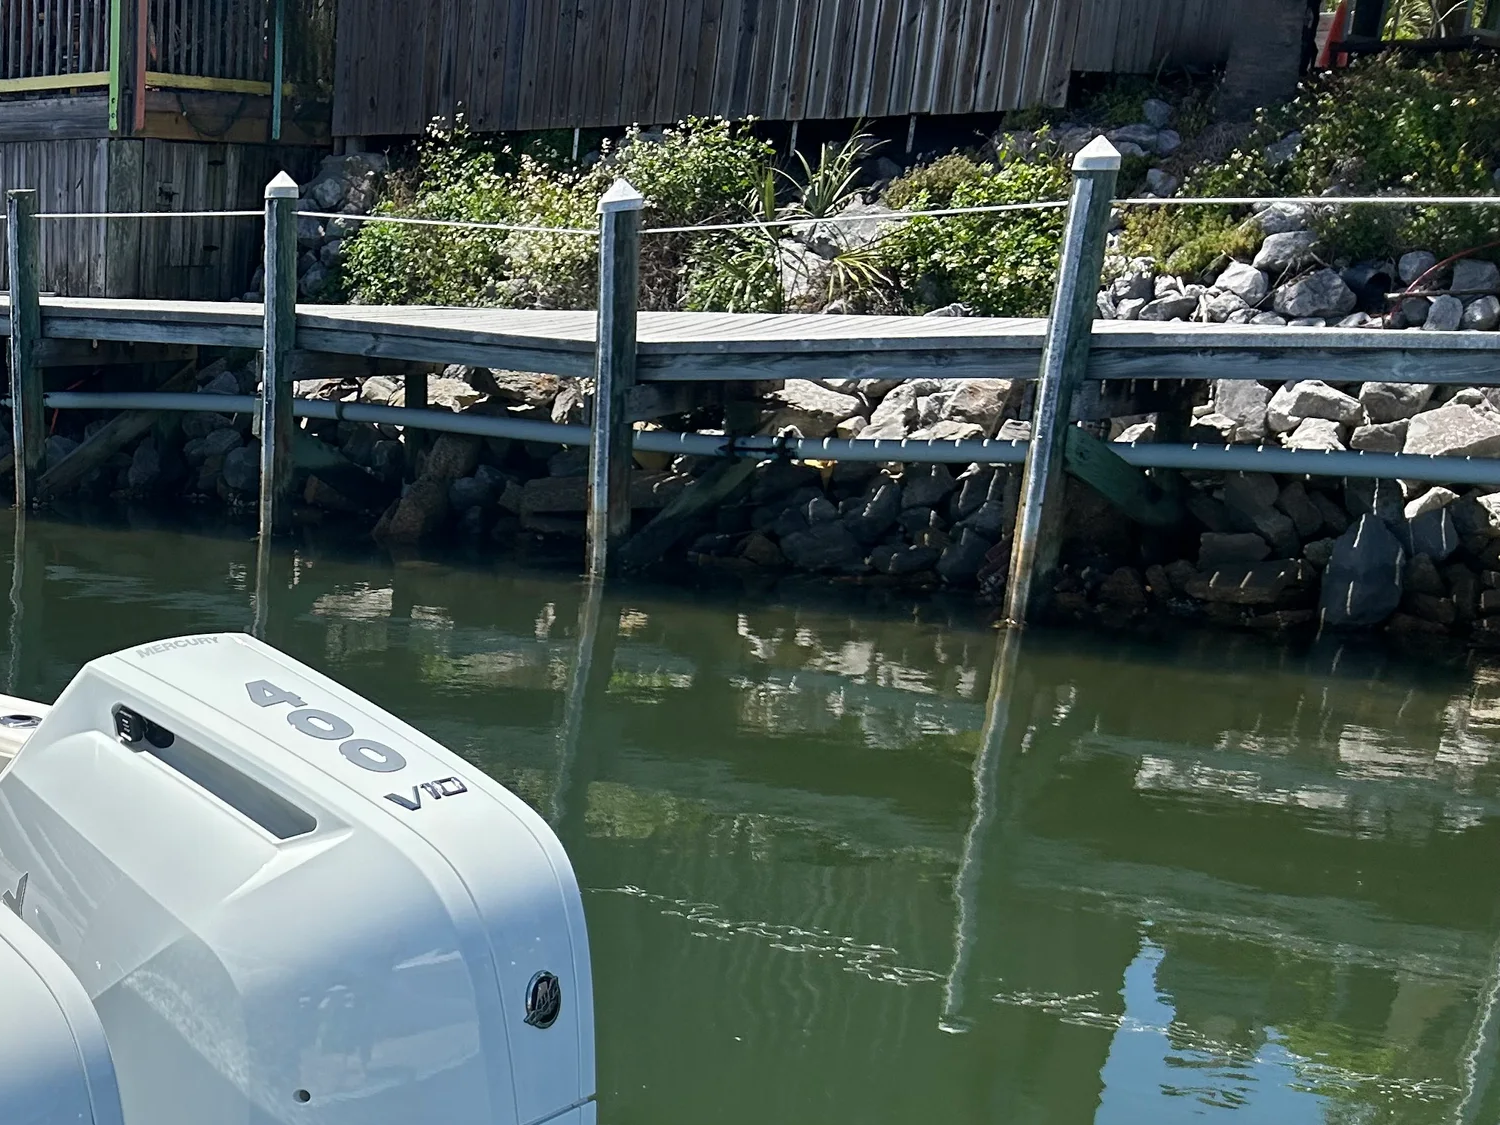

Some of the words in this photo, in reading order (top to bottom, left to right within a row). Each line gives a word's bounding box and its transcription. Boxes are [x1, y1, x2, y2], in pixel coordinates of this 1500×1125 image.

[136, 636, 219, 659] MERCURY
[245, 679, 407, 773] 400
[383, 776, 468, 811] V10
